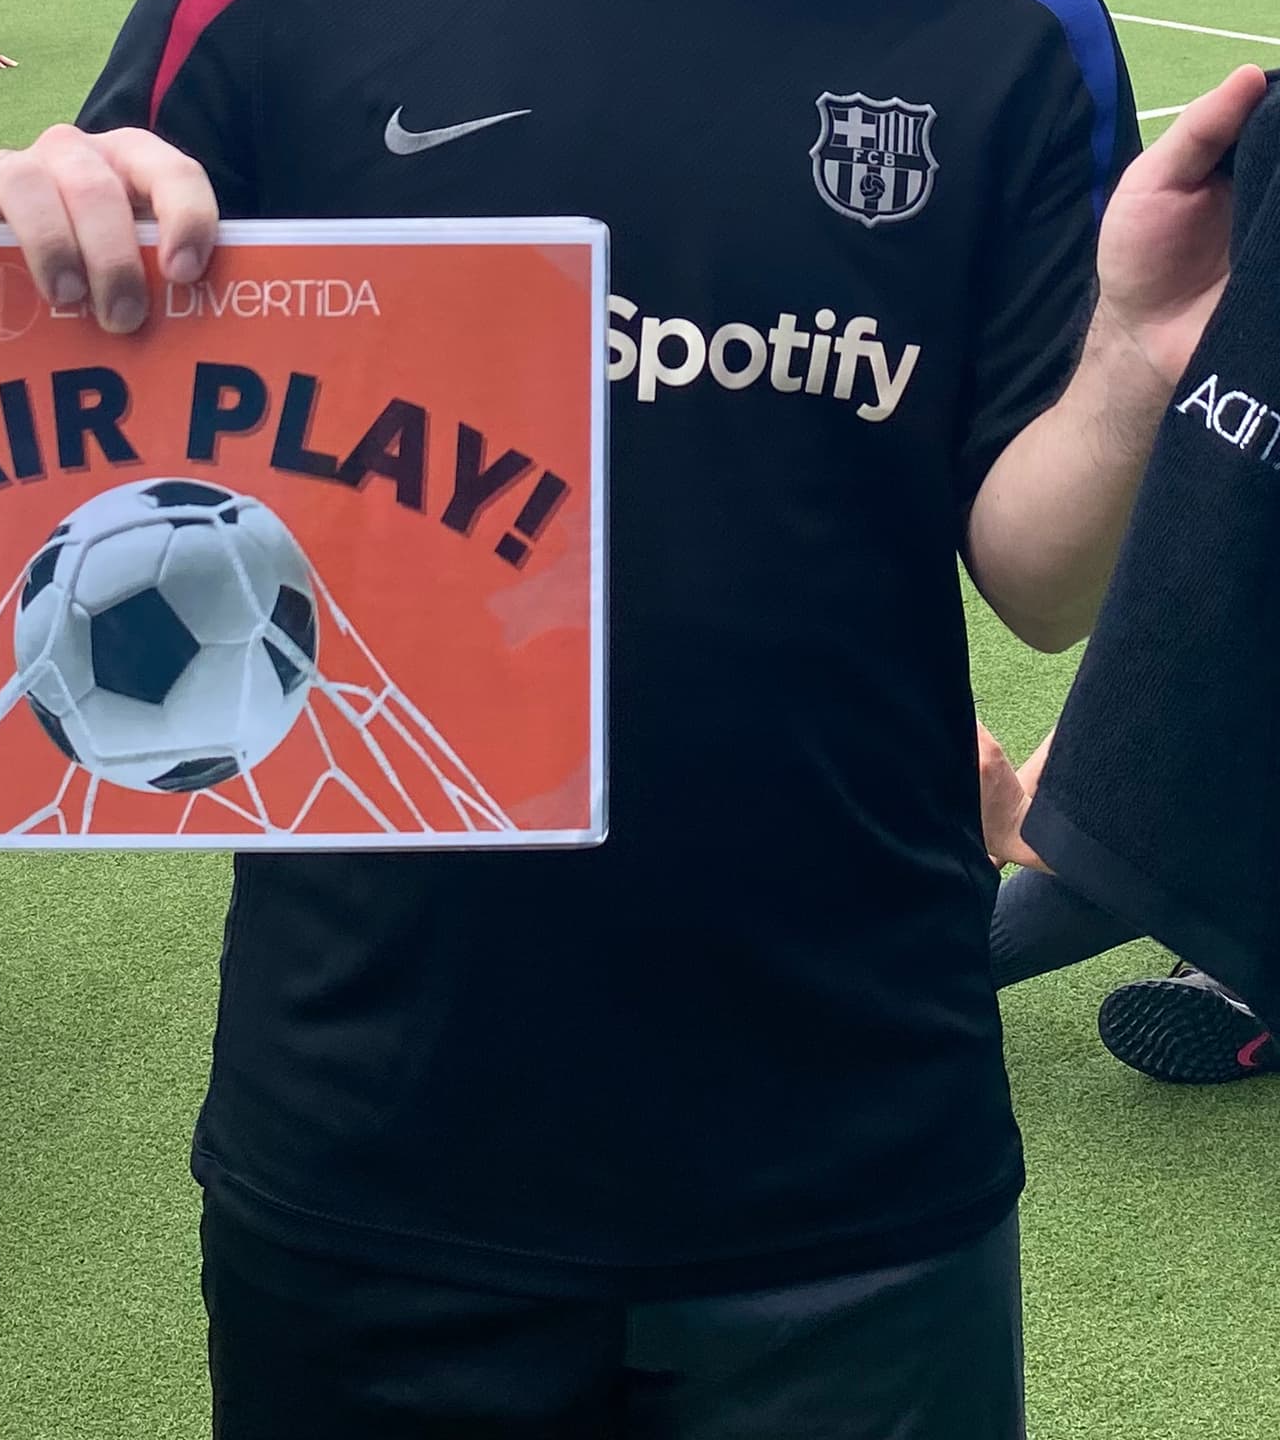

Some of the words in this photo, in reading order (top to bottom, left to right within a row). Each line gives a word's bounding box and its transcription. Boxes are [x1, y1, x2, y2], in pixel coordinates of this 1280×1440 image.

[852, 148, 896, 167] FCB
[607, 293, 921, 423] Spotify
[186, 361, 572, 570] PLAY!
